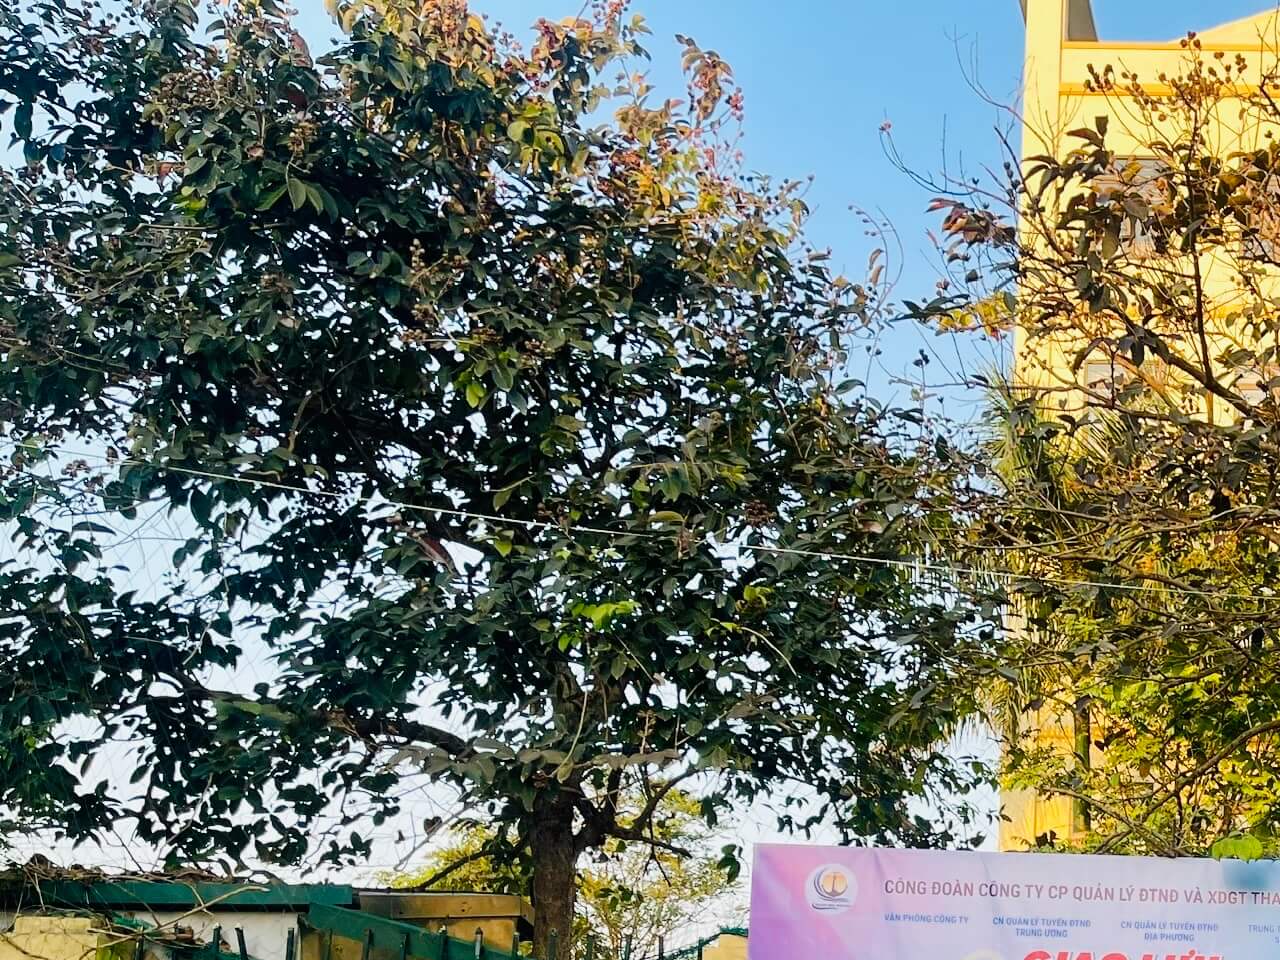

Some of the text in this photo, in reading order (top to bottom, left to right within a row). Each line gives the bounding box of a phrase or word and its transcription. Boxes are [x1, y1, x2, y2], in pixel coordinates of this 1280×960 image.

[885, 877, 926, 895] CÔNG
[932, 880, 973, 896] ĐOÀN
[979, 881, 1020, 897] CÔNG
[1024, 884, 1043, 898] TY
[1048, 885, 1068, 899] CP
[1073, 882, 1114, 901] QUẢN
[1120, 885, 1135, 901] LÝ
[1184, 886, 1203, 903] VÀ
[992, 917, 1004, 925] CN
[1120, 921, 1132, 929] CN
[1016, 928, 1042, 937] TRUNG
[1248, 924, 1275, 933] TRUNG
